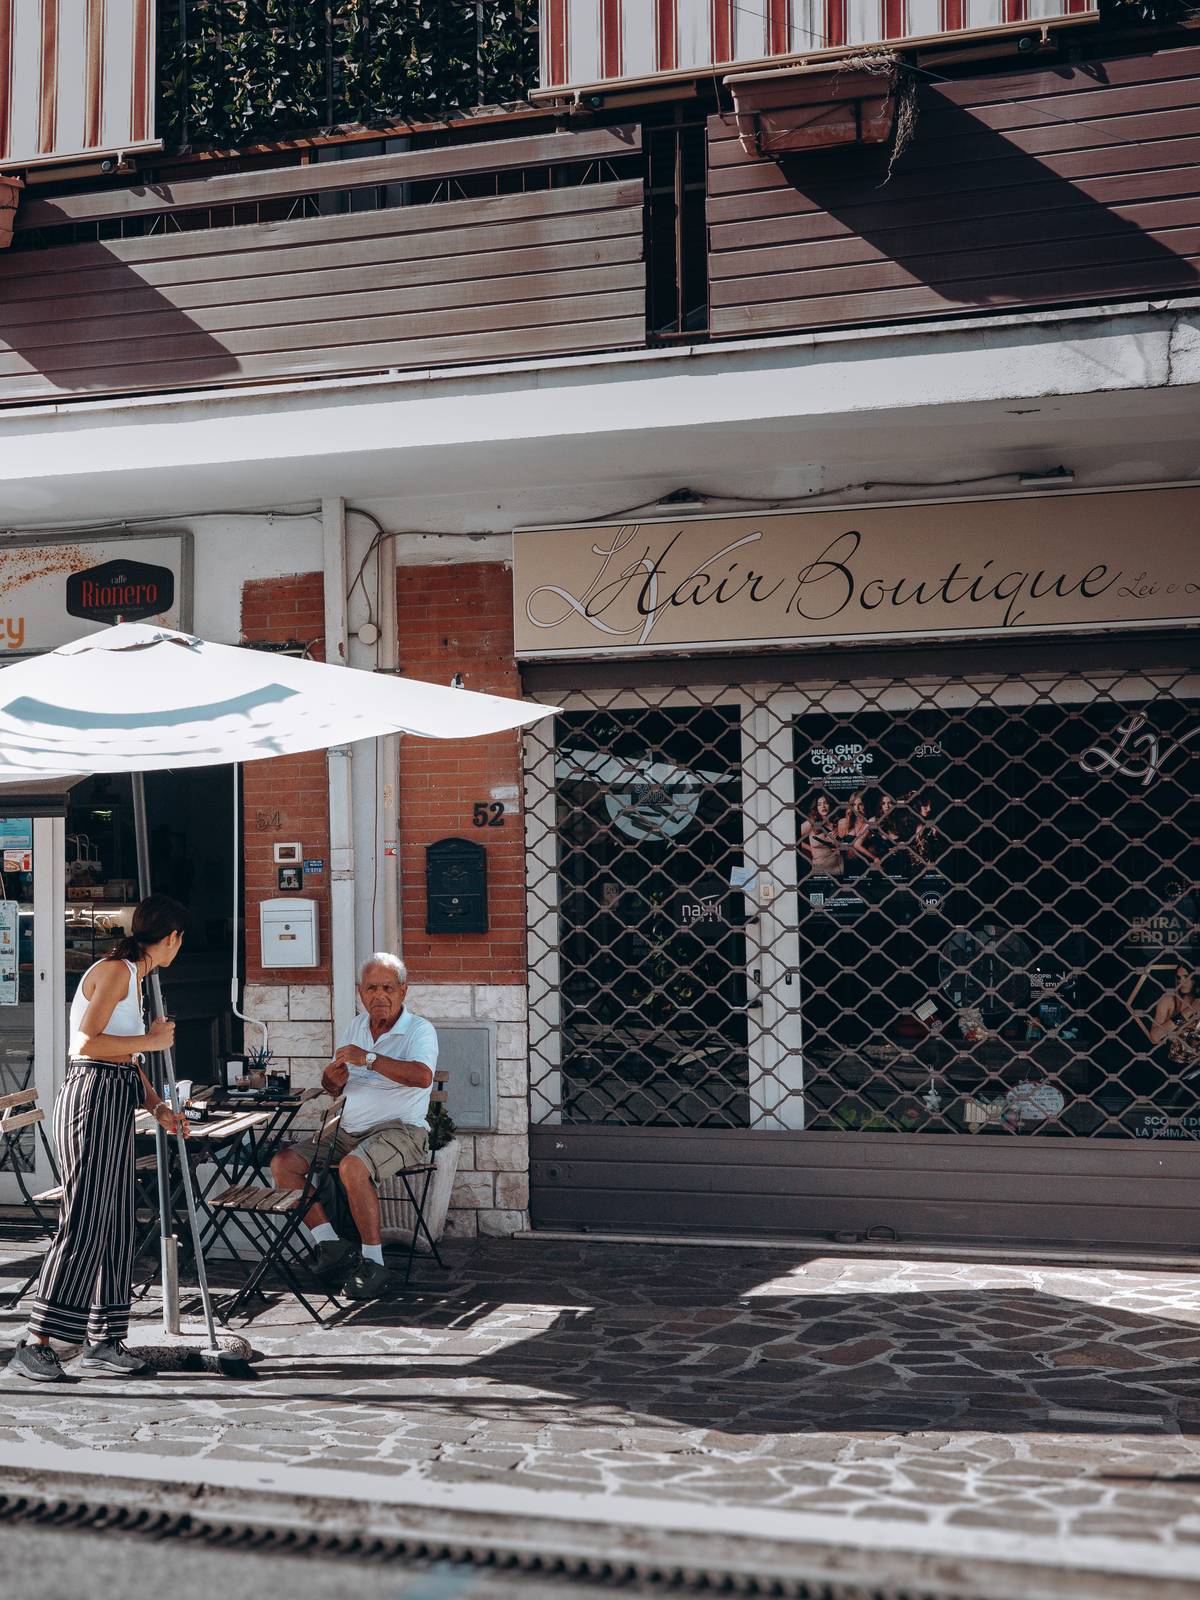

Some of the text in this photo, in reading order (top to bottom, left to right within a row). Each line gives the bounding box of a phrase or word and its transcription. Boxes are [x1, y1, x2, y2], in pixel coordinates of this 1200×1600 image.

[585, 531, 784, 617] Hair
[786, 530, 1121, 627] Boutique
[1118, 572, 1161, 599] Lei
[82, 580, 158, 608] Rionero
[835, 744, 863, 755] GHD
[811, 753, 874, 765] CHRONOS
[822, 763, 863, 774] CURVE
[472, 801, 505, 827] 52
[1144, 1116, 1186, 1126] SCOI
[1135, 1127, 1149, 1137] LA
